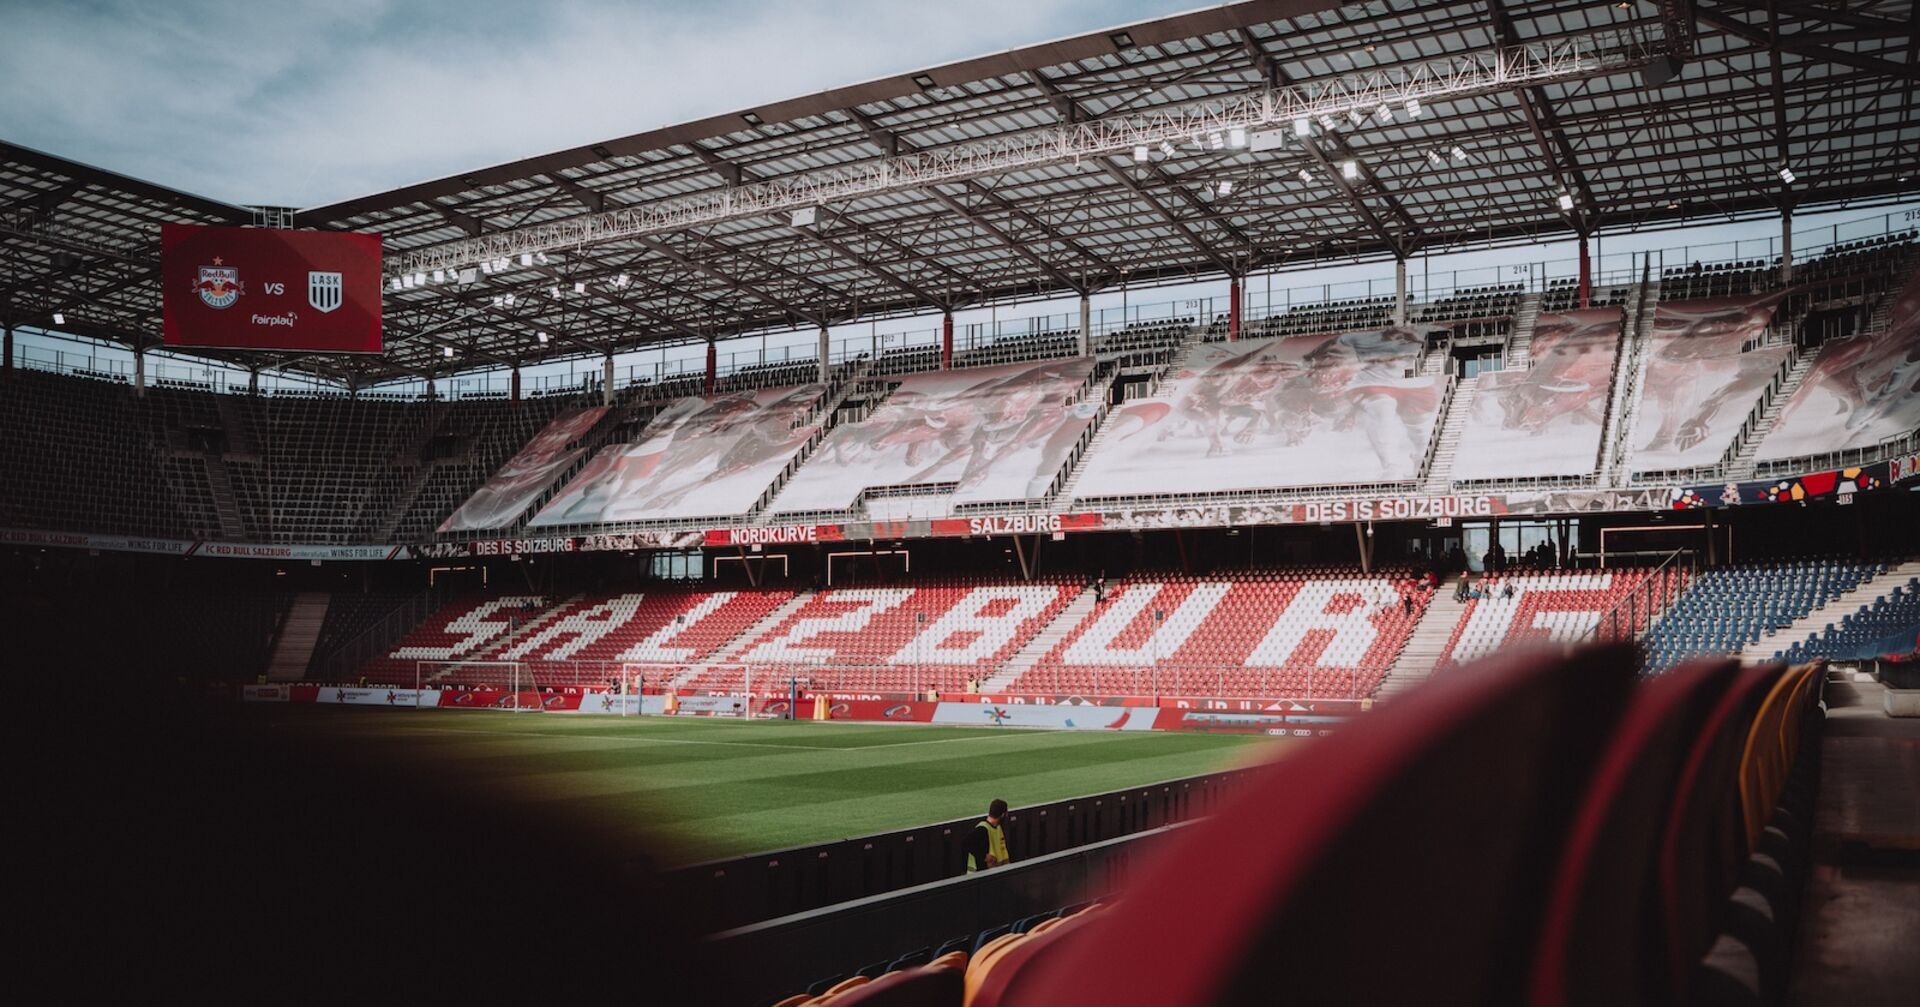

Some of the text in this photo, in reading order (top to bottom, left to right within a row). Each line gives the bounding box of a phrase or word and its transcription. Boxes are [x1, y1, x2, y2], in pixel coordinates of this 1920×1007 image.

[1513, 265, 1527, 274] 214
[312, 275, 339, 285] LASK
[1186, 300, 1198, 309] 213
[252, 313, 294, 327] fairplay
[1305, 503, 1349, 522] DES
[1352, 501, 1375, 520] IS
[969, 514, 1061, 534] SALZBURG
[730, 525, 817, 545] NORDKURVE
[49, 535, 89, 545] SALZBURG
[128, 540, 150, 550] WINGS
[152, 541, 166, 551] FOR
[168, 543, 183, 552] LIFE
[477, 540, 498, 556] DES
[500, 539, 512, 555] IS
[206, 545, 214, 553] FC
[216, 545, 231, 554] RED
[233, 546, 250, 555] BULL
[252, 547, 291, 557] SALZBURG
[330, 548, 353, 558] WINGS
[354, 548, 368, 558] FOR
[369, 549, 384, 558] LIFE
